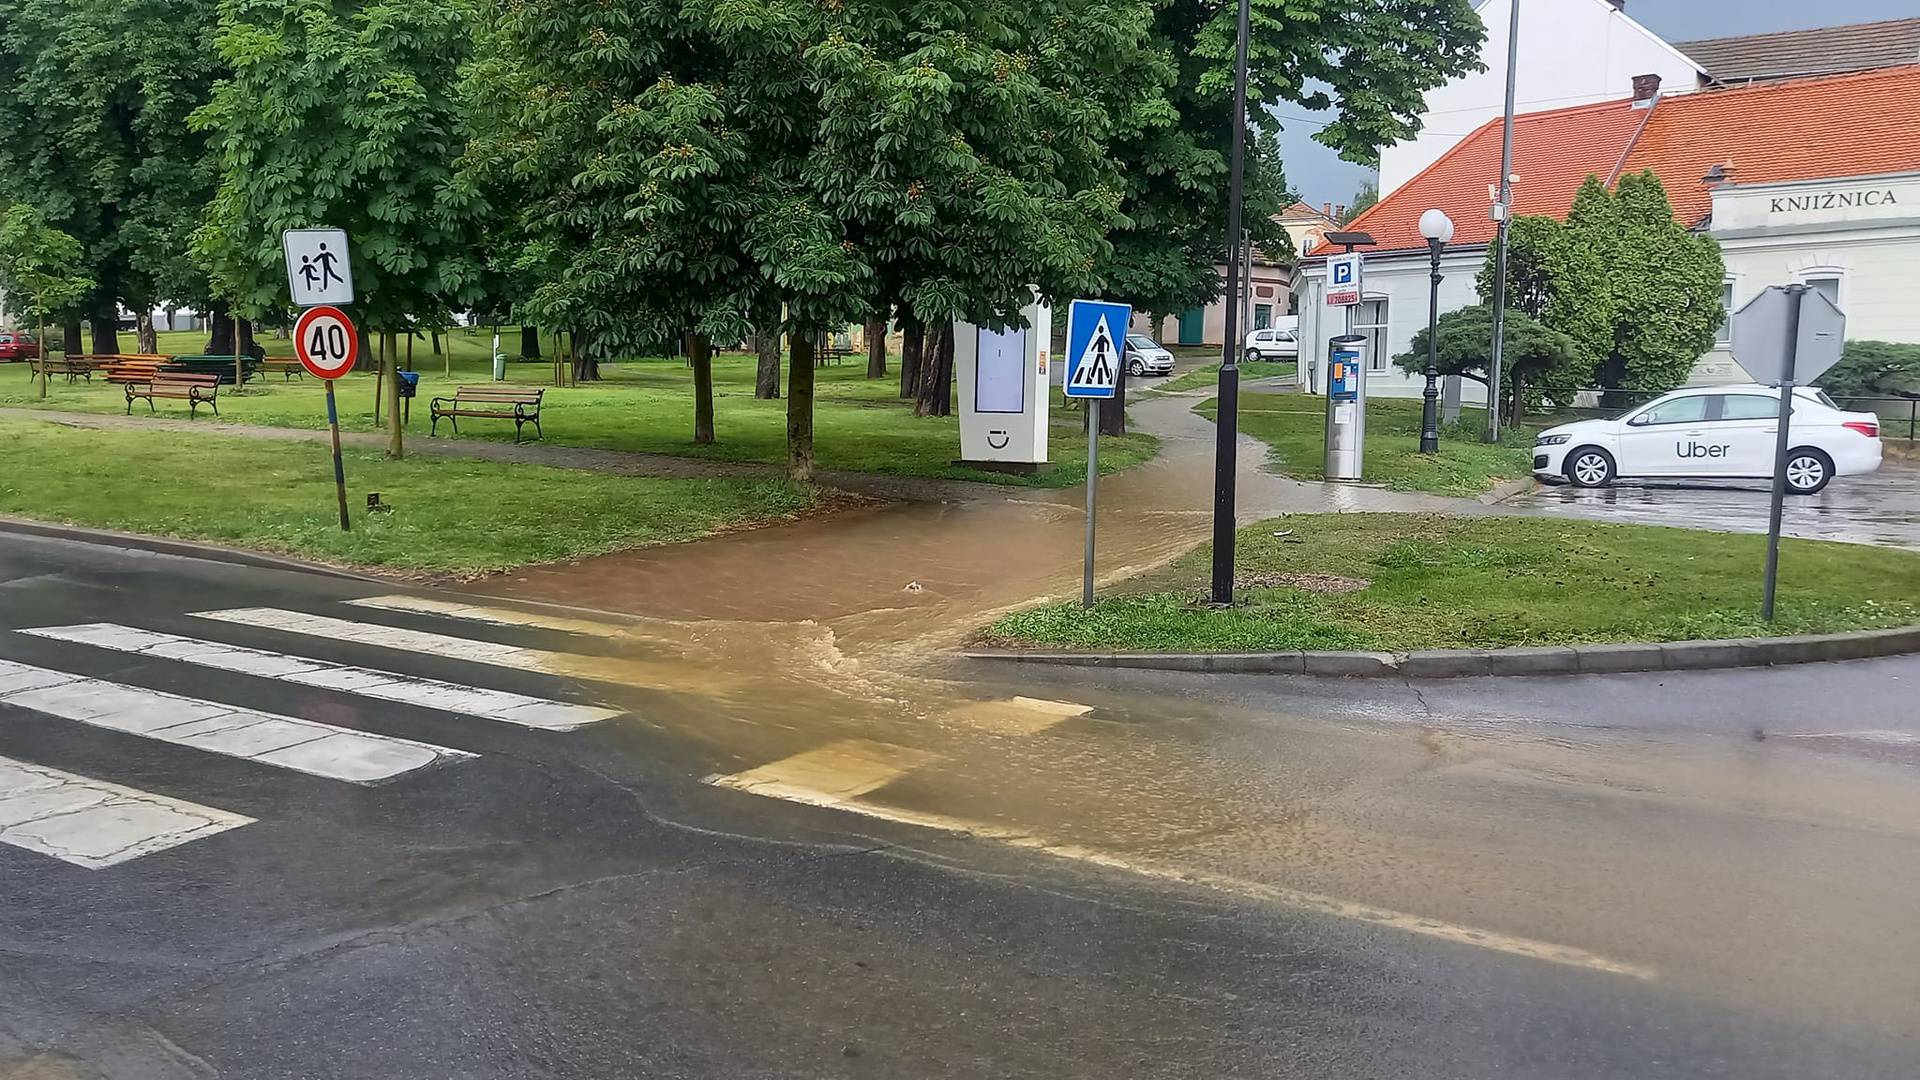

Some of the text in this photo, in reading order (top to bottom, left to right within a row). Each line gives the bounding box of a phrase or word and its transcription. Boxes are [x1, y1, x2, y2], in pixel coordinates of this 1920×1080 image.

[1769, 190, 1897, 212] KNJIŽNICA
[1338, 265, 1349, 282] P
[310, 324, 345, 360] 40
[1676, 441, 1730, 458] Uber
